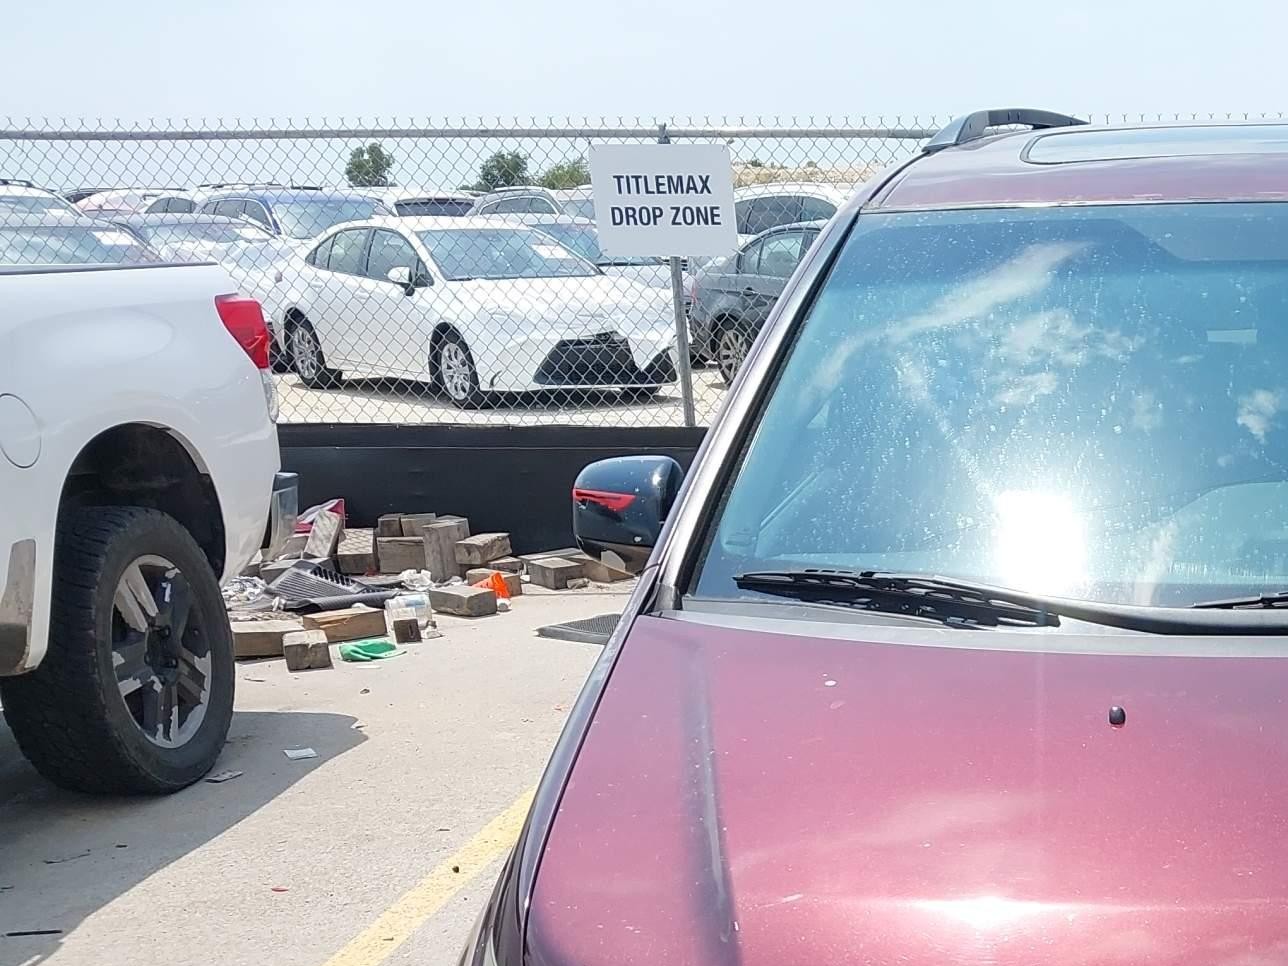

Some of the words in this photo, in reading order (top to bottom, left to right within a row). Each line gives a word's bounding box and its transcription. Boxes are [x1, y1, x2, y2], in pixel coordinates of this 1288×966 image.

[612, 175, 712, 195] TITLEMAX
[610, 206, 664, 226] DROP
[670, 205, 722, 226] ZONE
